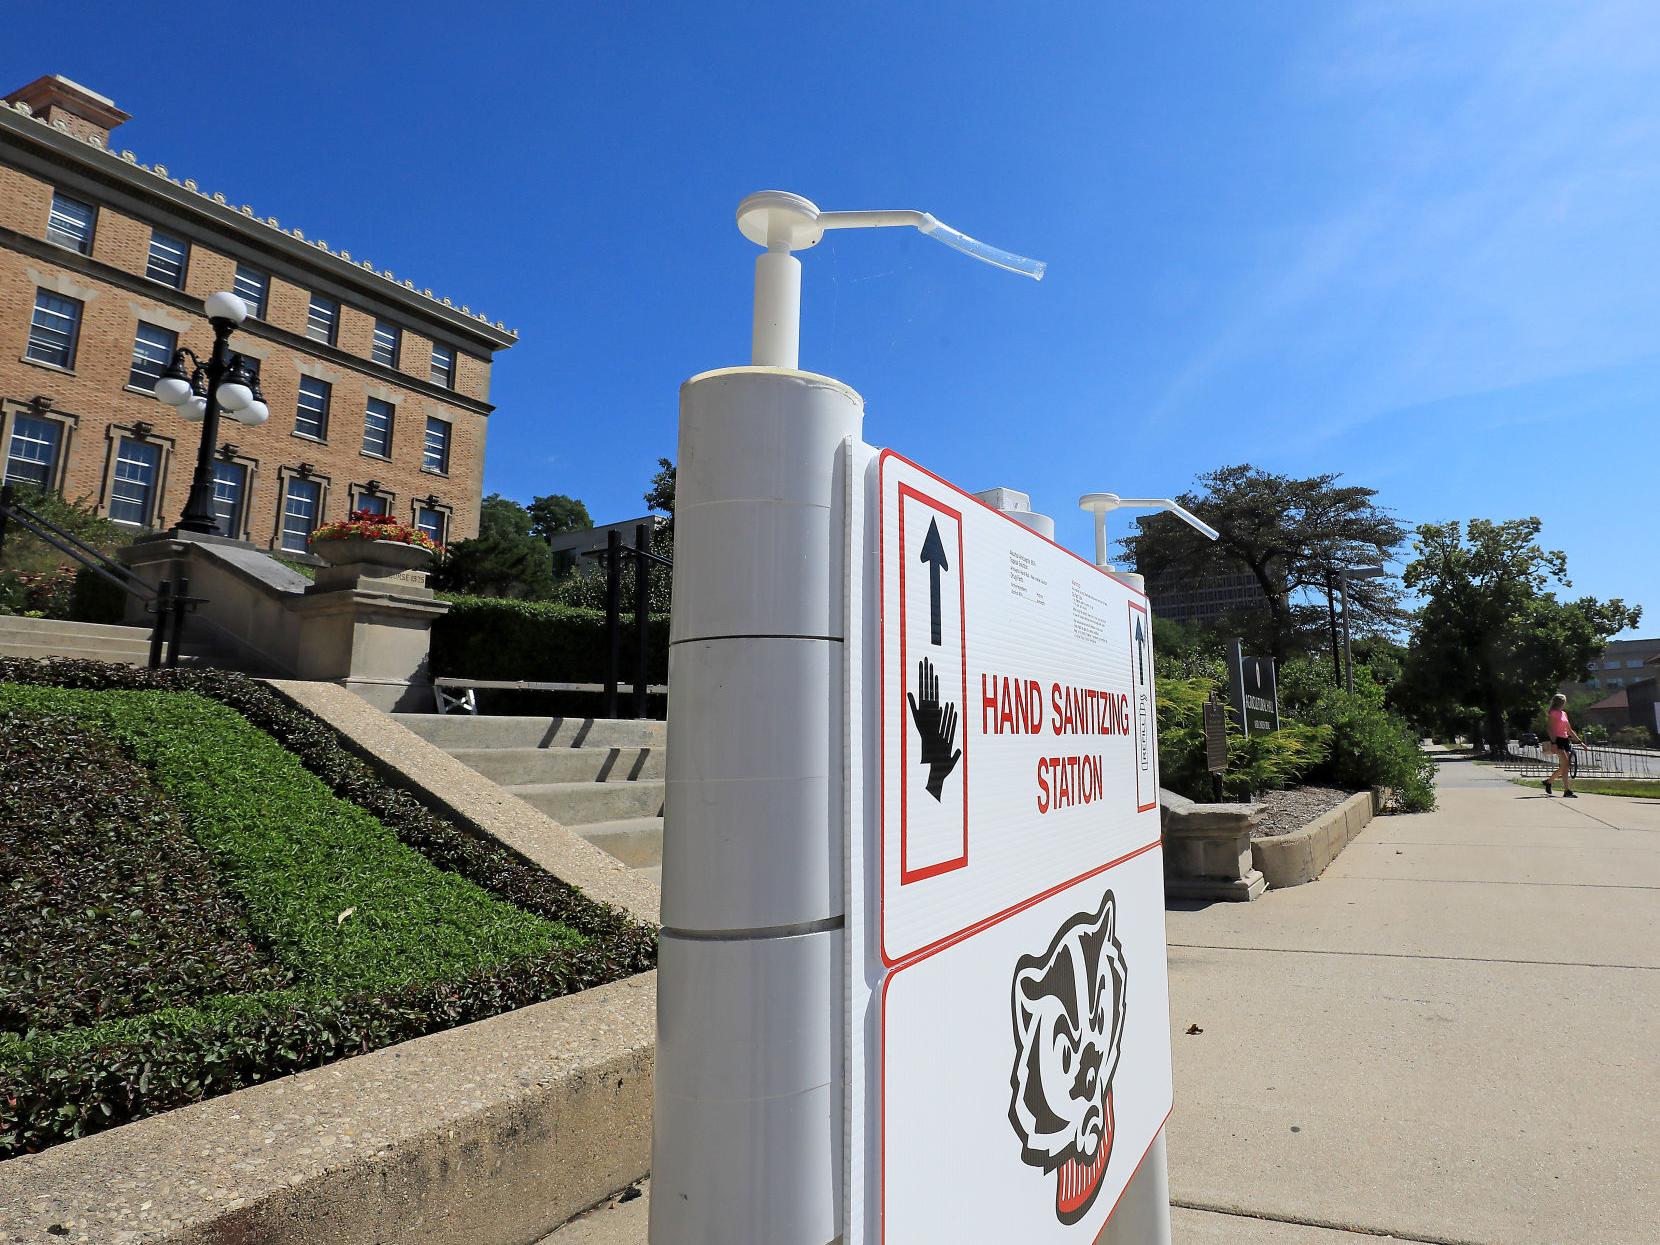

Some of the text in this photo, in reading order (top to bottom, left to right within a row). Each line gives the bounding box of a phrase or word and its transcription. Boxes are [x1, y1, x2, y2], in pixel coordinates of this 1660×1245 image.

[981, 673, 1130, 736] HAND SANITIZING
[1037, 754, 1103, 814] STATION
